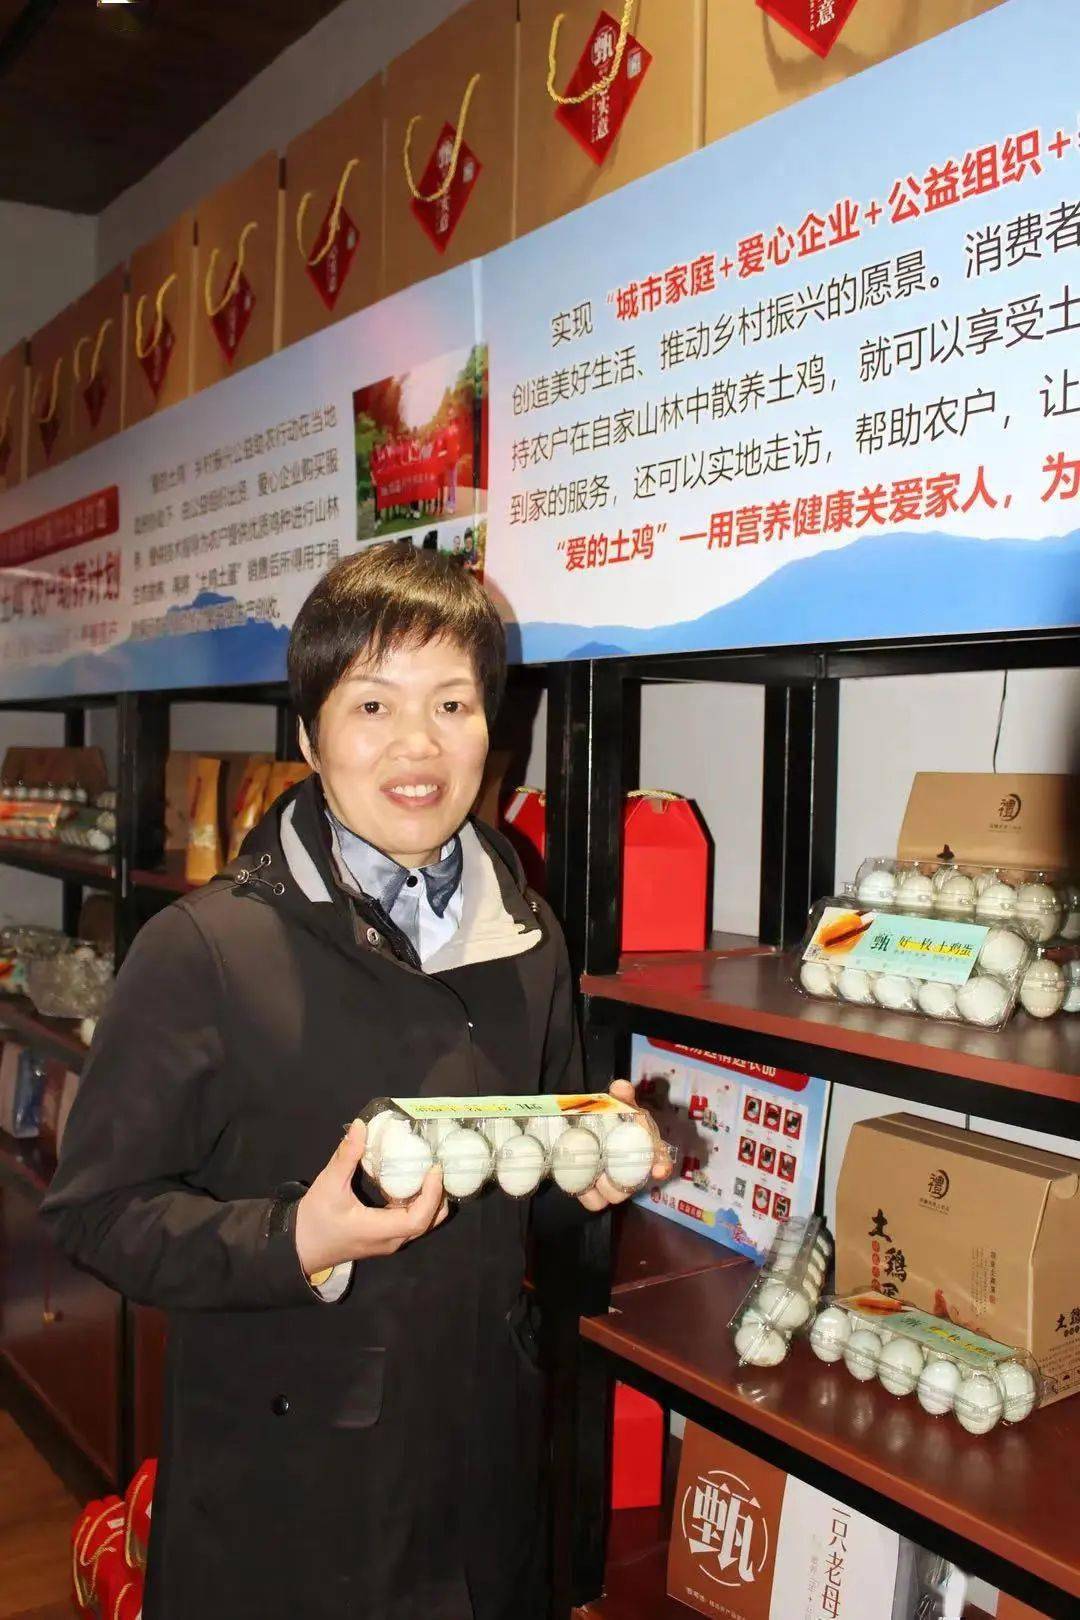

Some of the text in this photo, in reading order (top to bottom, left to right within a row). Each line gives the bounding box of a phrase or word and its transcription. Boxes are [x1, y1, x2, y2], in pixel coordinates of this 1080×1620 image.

[552, 129, 1080, 348] 实现“城市家庭+爱心企业+公益组织+
[822, 1507, 851, 1620] 一只老母
